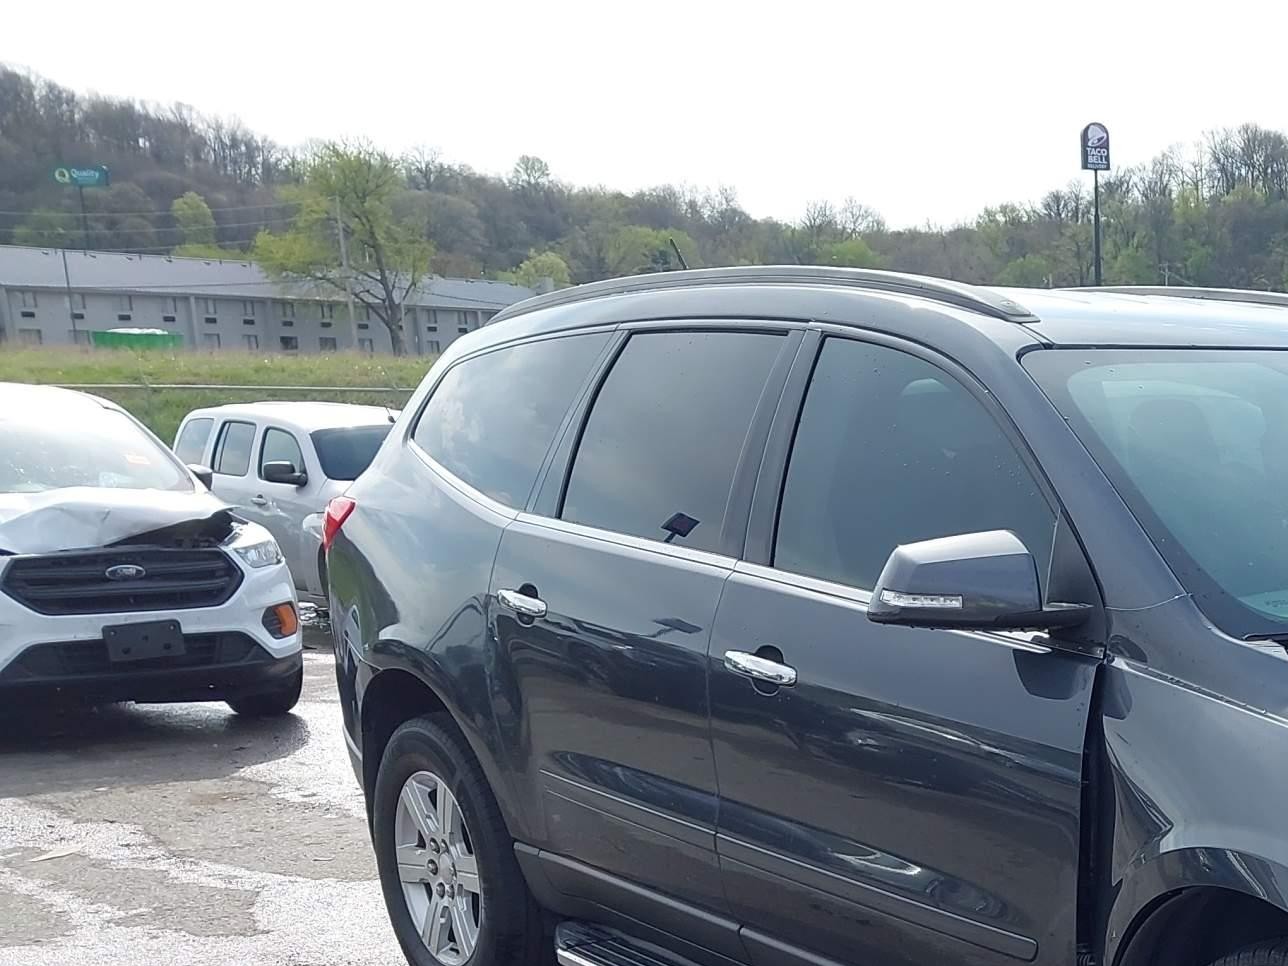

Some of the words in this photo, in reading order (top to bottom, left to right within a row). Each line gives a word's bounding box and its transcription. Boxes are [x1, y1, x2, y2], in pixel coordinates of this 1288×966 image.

[1086, 147, 1108, 156] TACO
[1087, 156, 1108, 164] BELL
[70, 168, 99, 179] Quality
